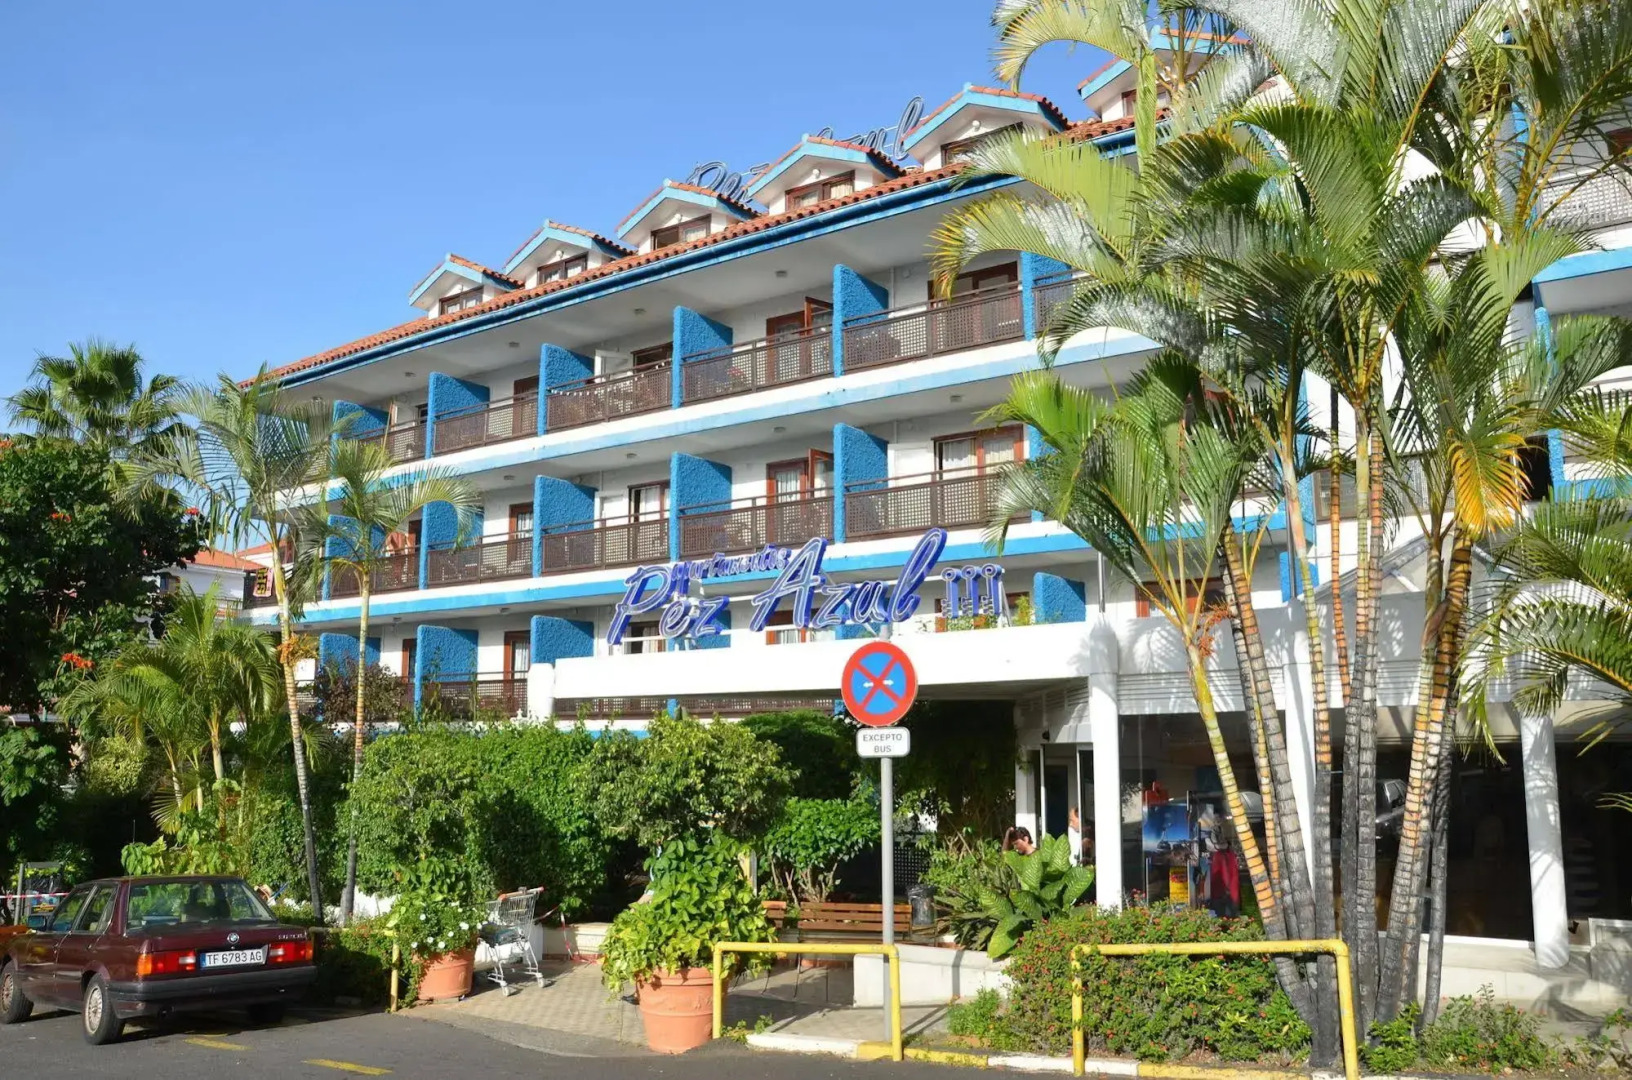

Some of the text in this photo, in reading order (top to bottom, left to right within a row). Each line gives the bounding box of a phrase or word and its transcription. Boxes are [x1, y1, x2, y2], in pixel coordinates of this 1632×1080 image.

[606, 528, 948, 645] Pez Azul
[863, 733, 903, 742] EXCEPTO
[874, 745, 892, 753] BUS
[207, 951, 262, 965] TF 6783 AG
